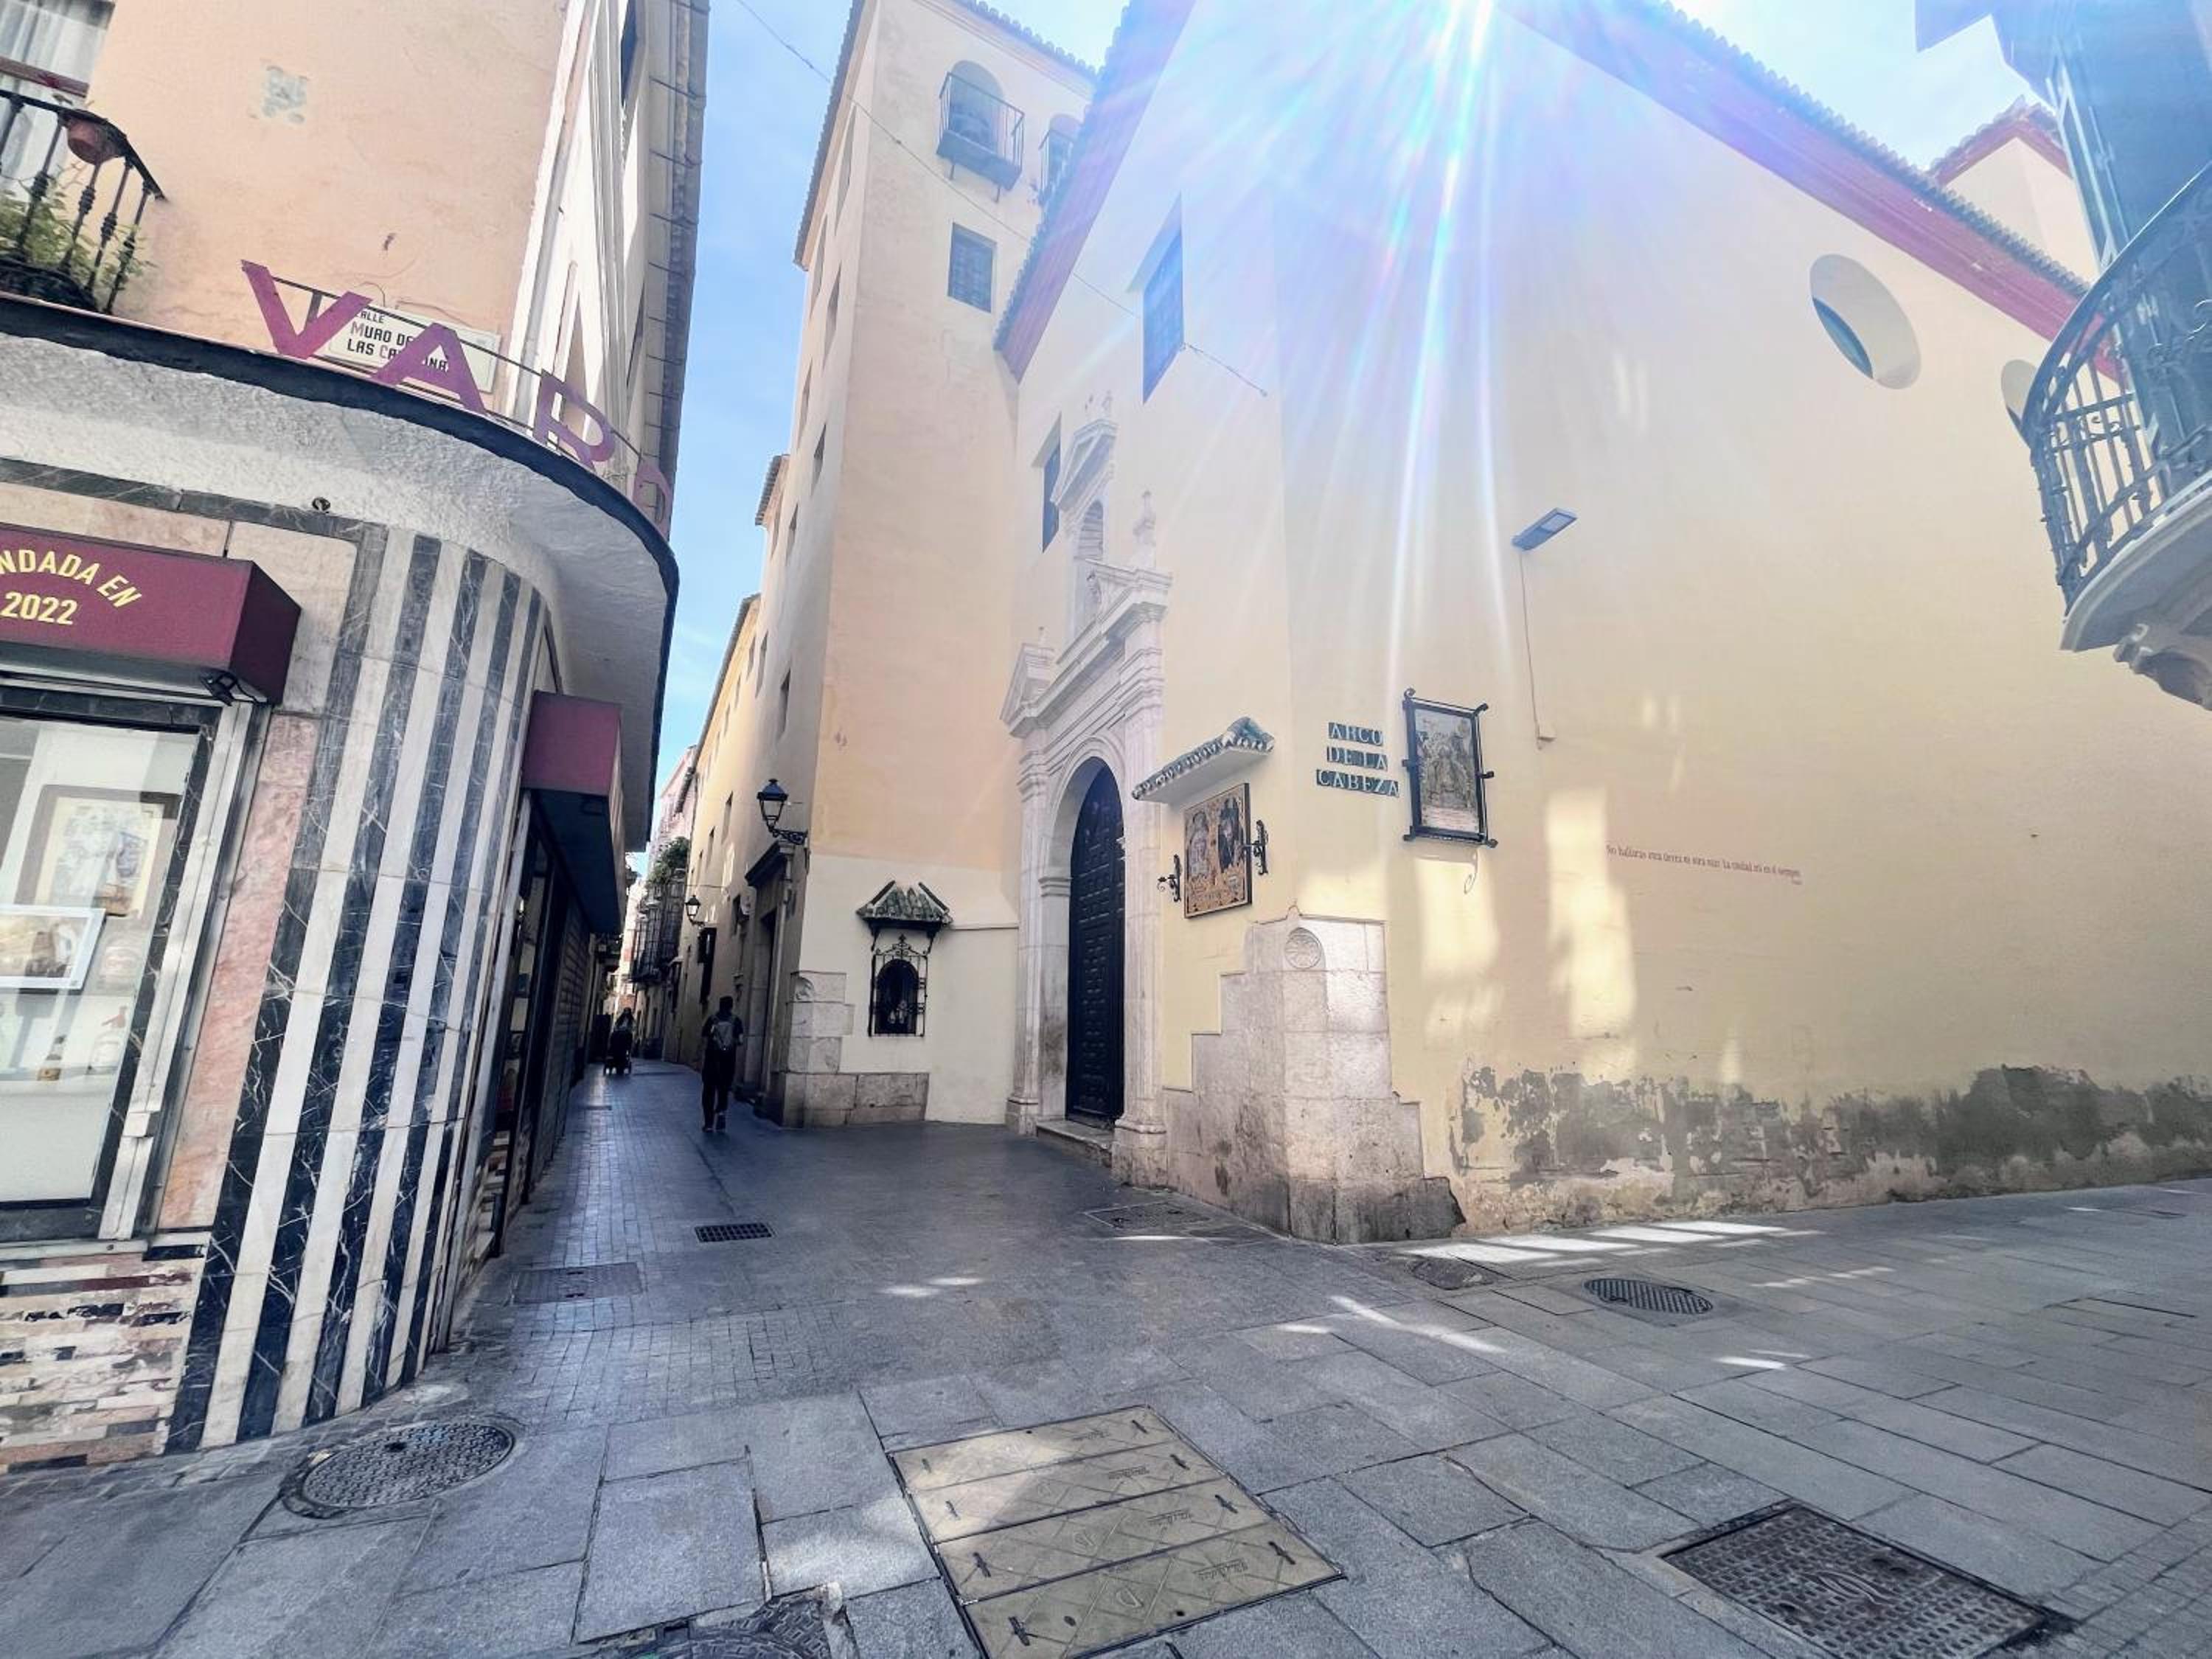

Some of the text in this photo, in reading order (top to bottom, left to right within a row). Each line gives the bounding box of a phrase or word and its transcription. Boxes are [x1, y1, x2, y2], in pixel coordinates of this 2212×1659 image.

[357, 310, 384, 324] ALLE
[351, 321, 392, 343] MURO
[347, 338, 375, 356] LAS
[97, 574, 142, 608] EN
[0, 591, 77, 625] 2022
[1329, 723, 1384, 746] ARCO
[1328, 745, 1388, 771] DE LA
[1318, 770, 1399, 797] CABEZA
